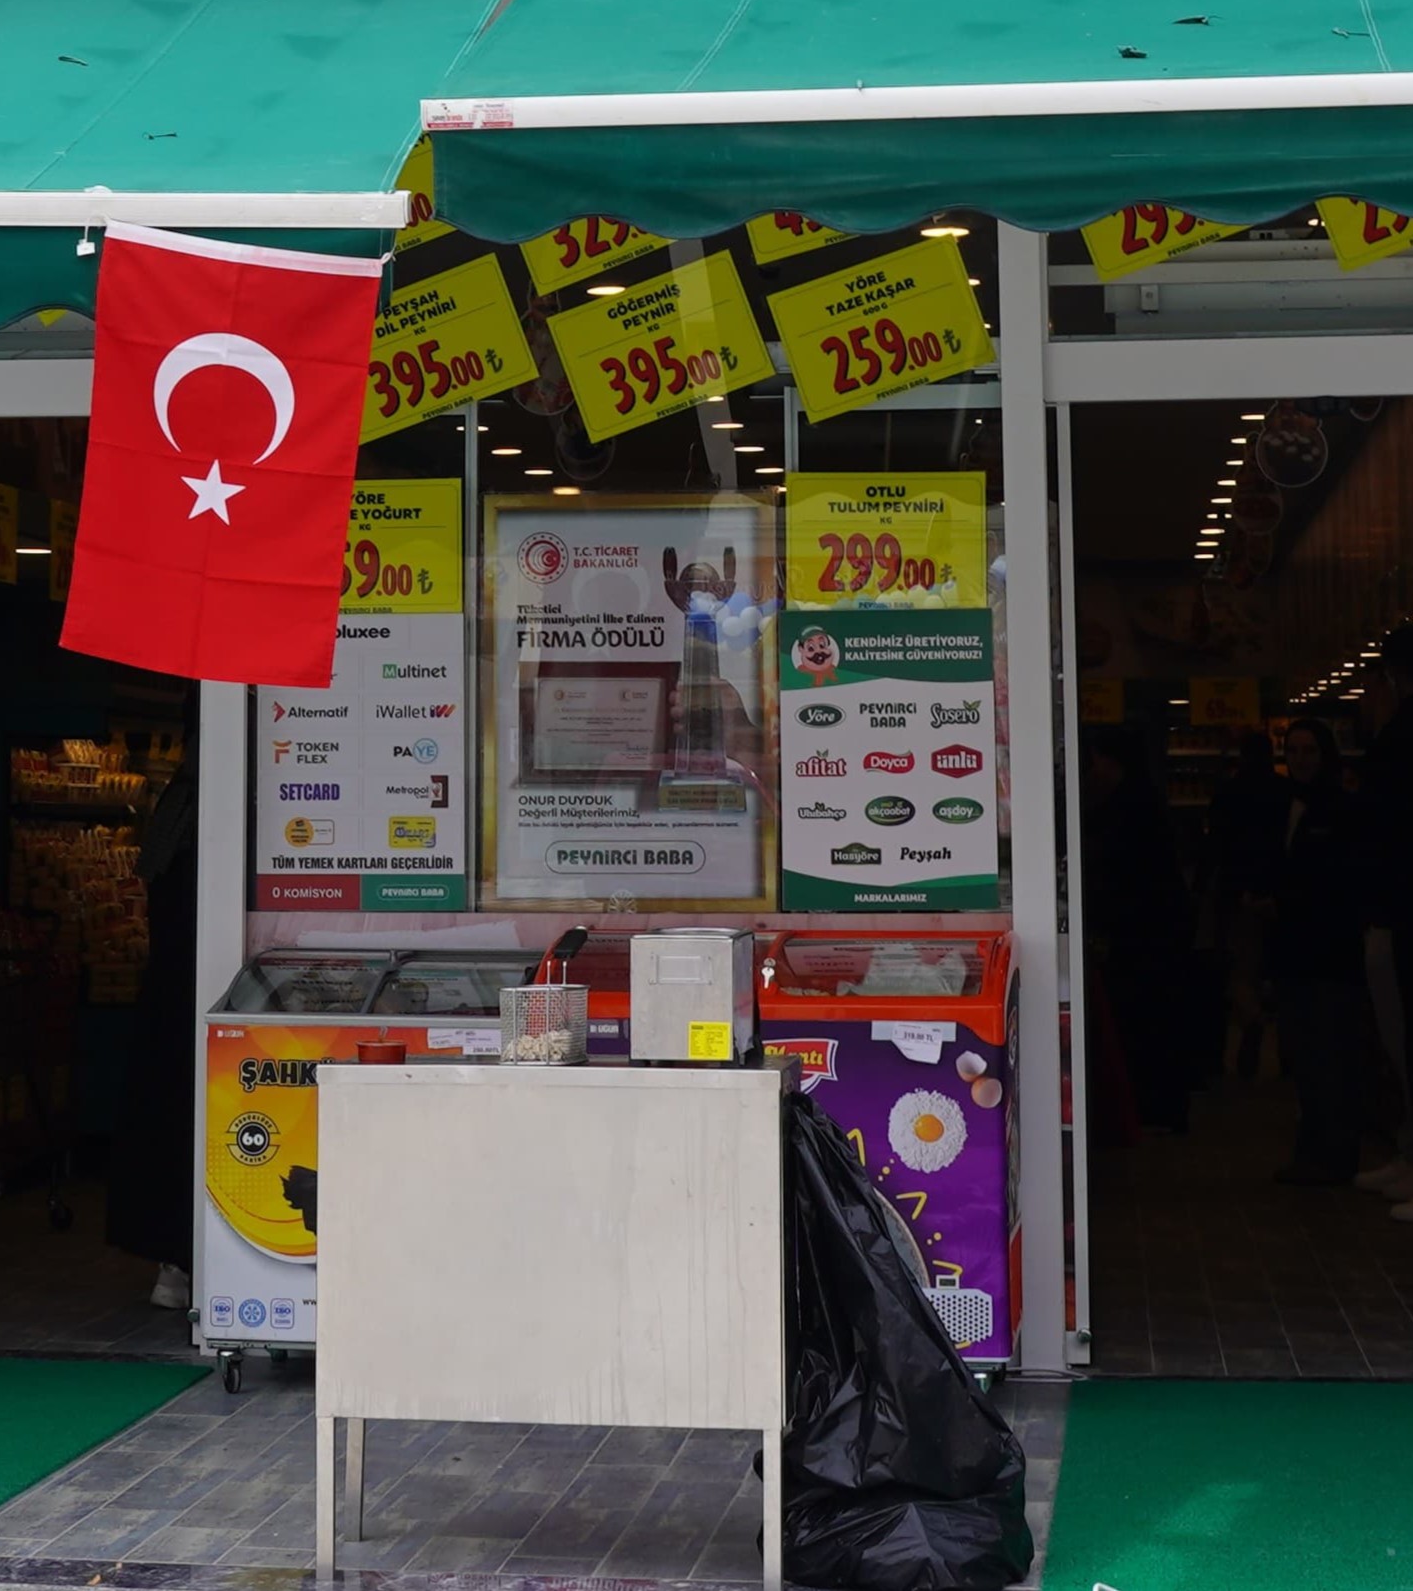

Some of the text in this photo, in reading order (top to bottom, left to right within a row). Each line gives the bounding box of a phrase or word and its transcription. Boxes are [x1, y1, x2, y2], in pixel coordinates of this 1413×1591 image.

[845, 271, 887, 294] YÖRE
[607, 283, 682, 321] GÖĞERMİŞ
[826, 277, 916, 316] TAZE KAŞAR
[383, 290, 439, 319] PEYŞAH
[375, 299, 457, 338] DİL PEYNİRİ
[622, 302, 676, 331] PEYNİR
[820, 318, 942, 394] 259.00
[368, 339, 485, 417] 395.00
[600, 336, 721, 415] 395.00
[351, 491, 385, 504] ÖRE
[866, 486, 906, 498] OTLU
[828, 498, 944, 513] TULUM PEYNİRİ
[361, 507, 422, 520] YOĞURT
[573, 545, 639, 557] T.C. TİCARET
[573, 557, 639, 568] BAKANLIĞI
[818, 532, 935, 592] 299.00
[516, 612, 665, 627] Memnuniyetini İlke Edinen
[517, 626, 665, 648] FİRMA ÖDÜLÜ
[844, 633, 983, 648] KENDİMİZ ÜRETİYORUZ,
[844, 648, 982, 660] KALİTESİNE GÜVENİYORUZ!
[382, 663, 447, 679] Multinet
[288, 706, 348, 719] Alternatif
[376, 704, 427, 719] iWallet
[859, 702, 917, 714] PEYNİRCİ
[870, 716, 906, 728] BABA
[296, 742, 339, 752] TOKEN
[297, 754, 328, 764] FLEX
[937, 751, 977, 769] ünlü
[279, 783, 340, 801] SETCARD
[386, 785, 429, 798] Metropol
[518, 795, 613, 806] ONUR DUYDUK
[518, 807, 640, 819] Değerli Müşterilerimiz,
[557, 849, 694, 865] PEYNİRCİ BABA
[900, 846, 951, 863] Peyşah
[272, 855, 453, 871] TÜM YEMEK KARTLARI GEÇERLİDİR
[272, 885, 342, 899] 0 KOMİSYON
[854, 893, 927, 903] MARKALARIMIZ
[239, 1057, 335, 1093] ŞAHK
[241, 1131, 265, 1147] 60
